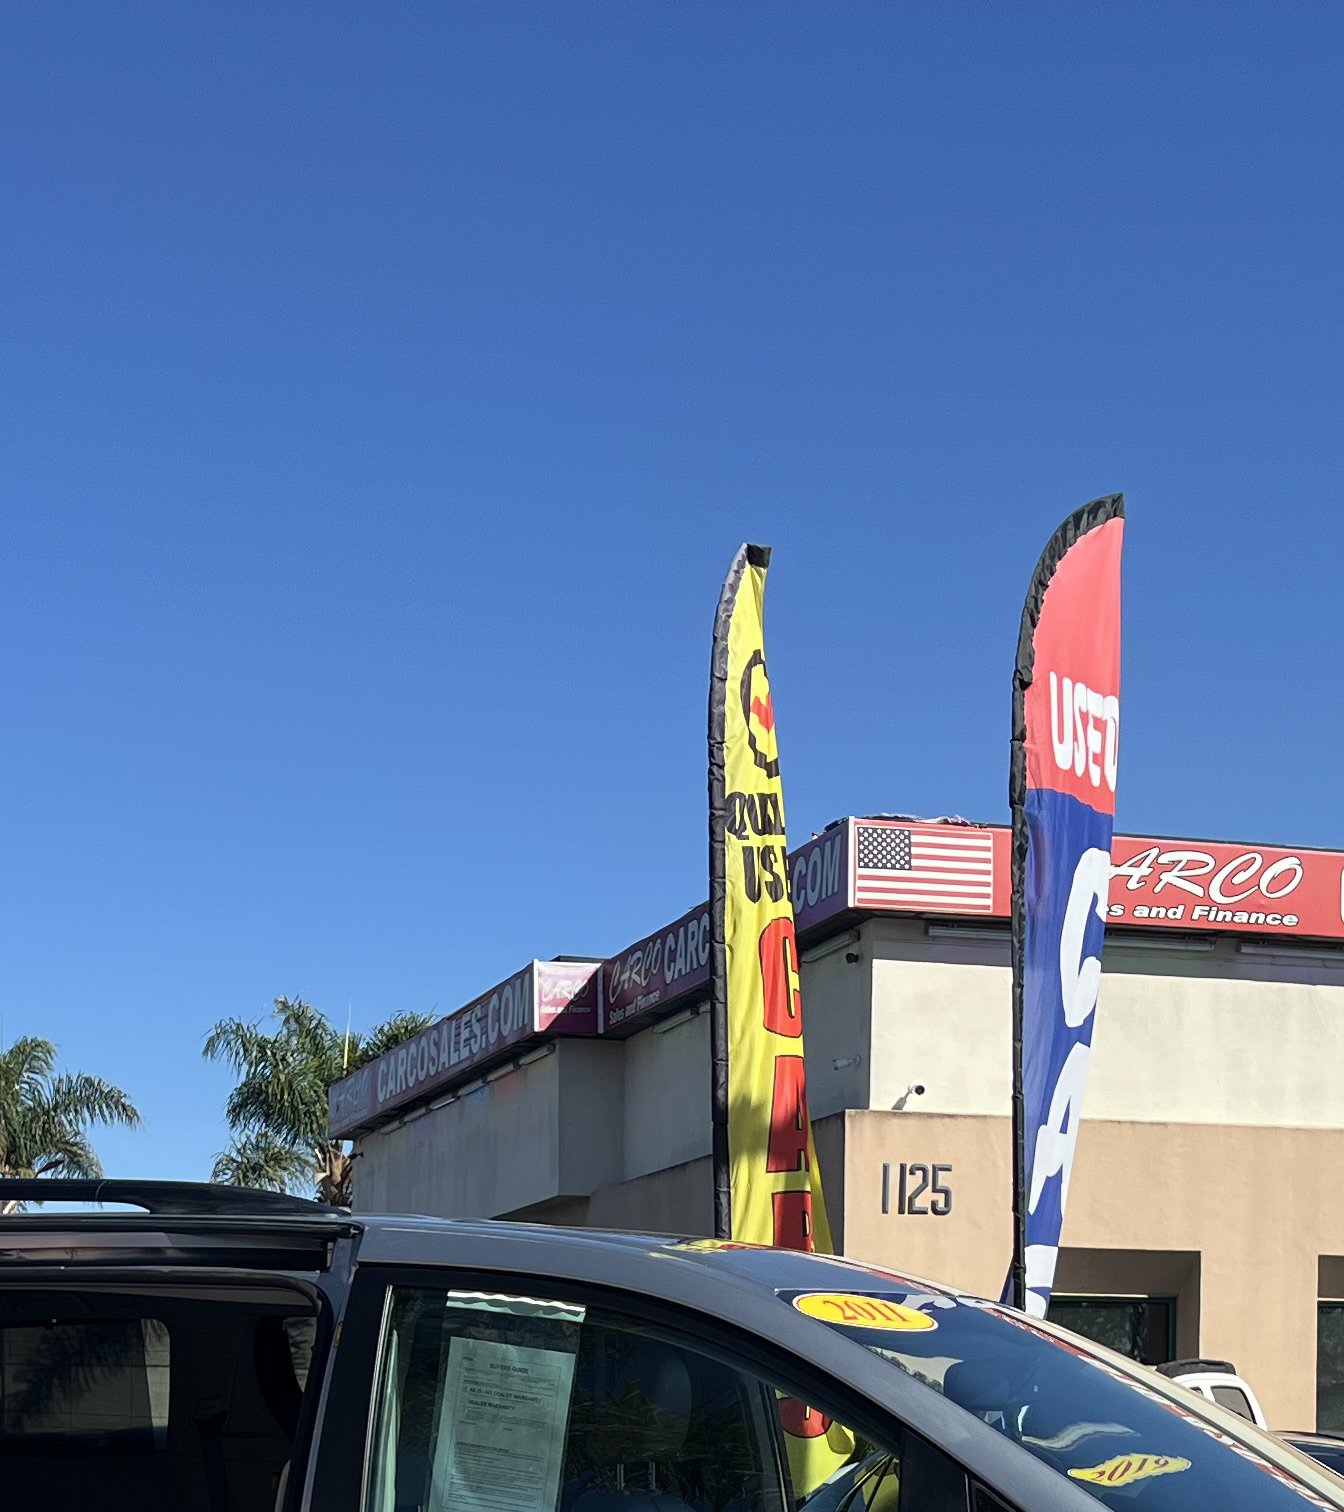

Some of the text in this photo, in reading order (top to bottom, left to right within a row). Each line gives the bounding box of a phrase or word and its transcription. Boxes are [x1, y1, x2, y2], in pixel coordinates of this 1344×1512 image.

[1109, 846, 1304, 905] ARCO
[1132, 903, 1185, 920] and
[1190, 904, 1300, 927] Finance
[378, 972, 530, 1103] CARCOSALES.COM
[881, 1163, 952, 1216] 1125
[823, 1300, 912, 1322] 2011
[1090, 1457, 1169, 1482] 2019
